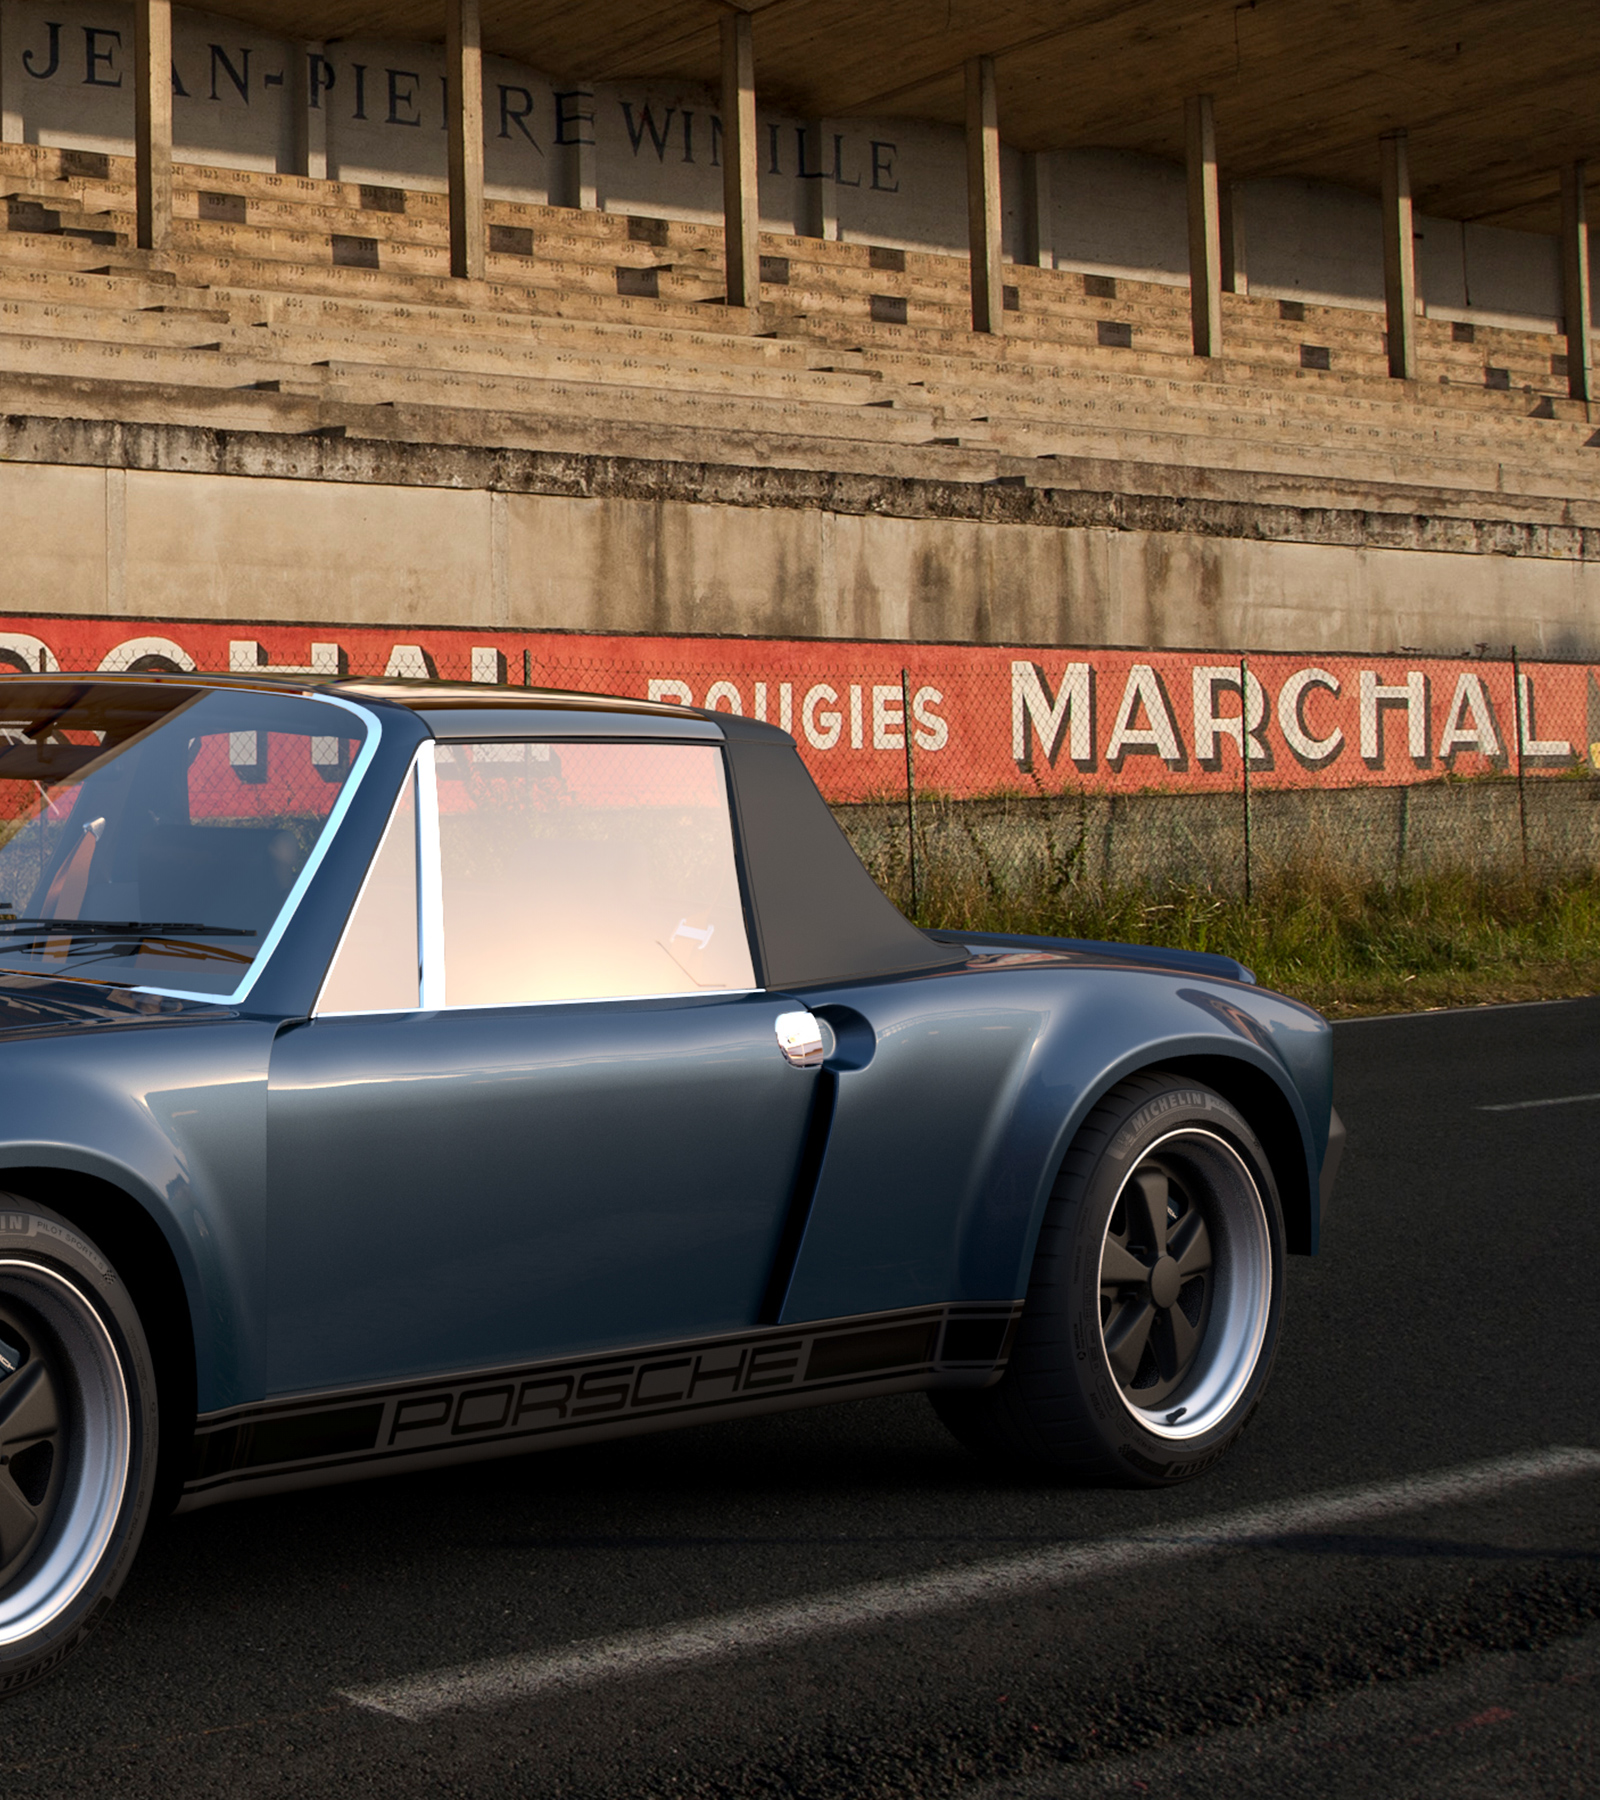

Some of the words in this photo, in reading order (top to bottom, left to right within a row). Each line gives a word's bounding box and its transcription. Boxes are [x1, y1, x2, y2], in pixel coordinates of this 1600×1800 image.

[22, 21, 595, 158] JEN-PIERE
[1011, 661, 1573, 765] MARCHAL
[1132, 1092, 1202, 1132] MICHELIN
[36, 1221, 64, 1237] PILOT
[64, 1233, 94, 1258] SPORT
[387, 1340, 805, 1446] PORSCHE
